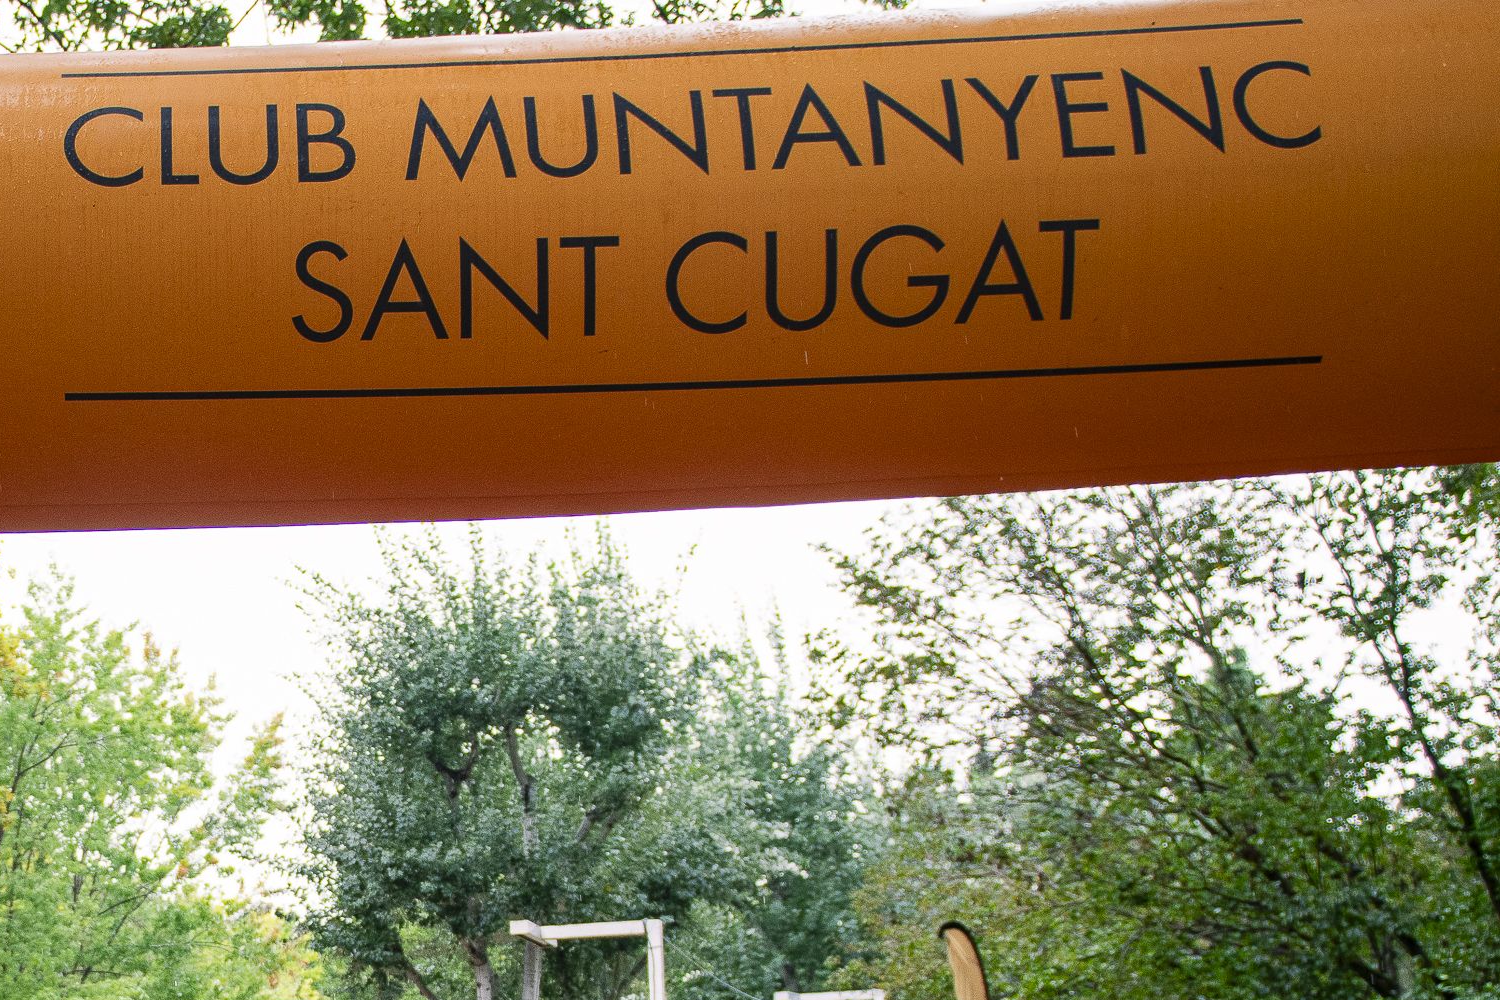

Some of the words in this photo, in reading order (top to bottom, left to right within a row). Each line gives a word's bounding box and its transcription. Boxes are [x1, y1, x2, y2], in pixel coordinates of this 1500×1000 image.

[62, 103, 358, 189] CLUB
[404, 59, 1324, 182] MUNTANYENC
[290, 235, 621, 343] SANT
[664, 218, 1101, 336] CUGAT
